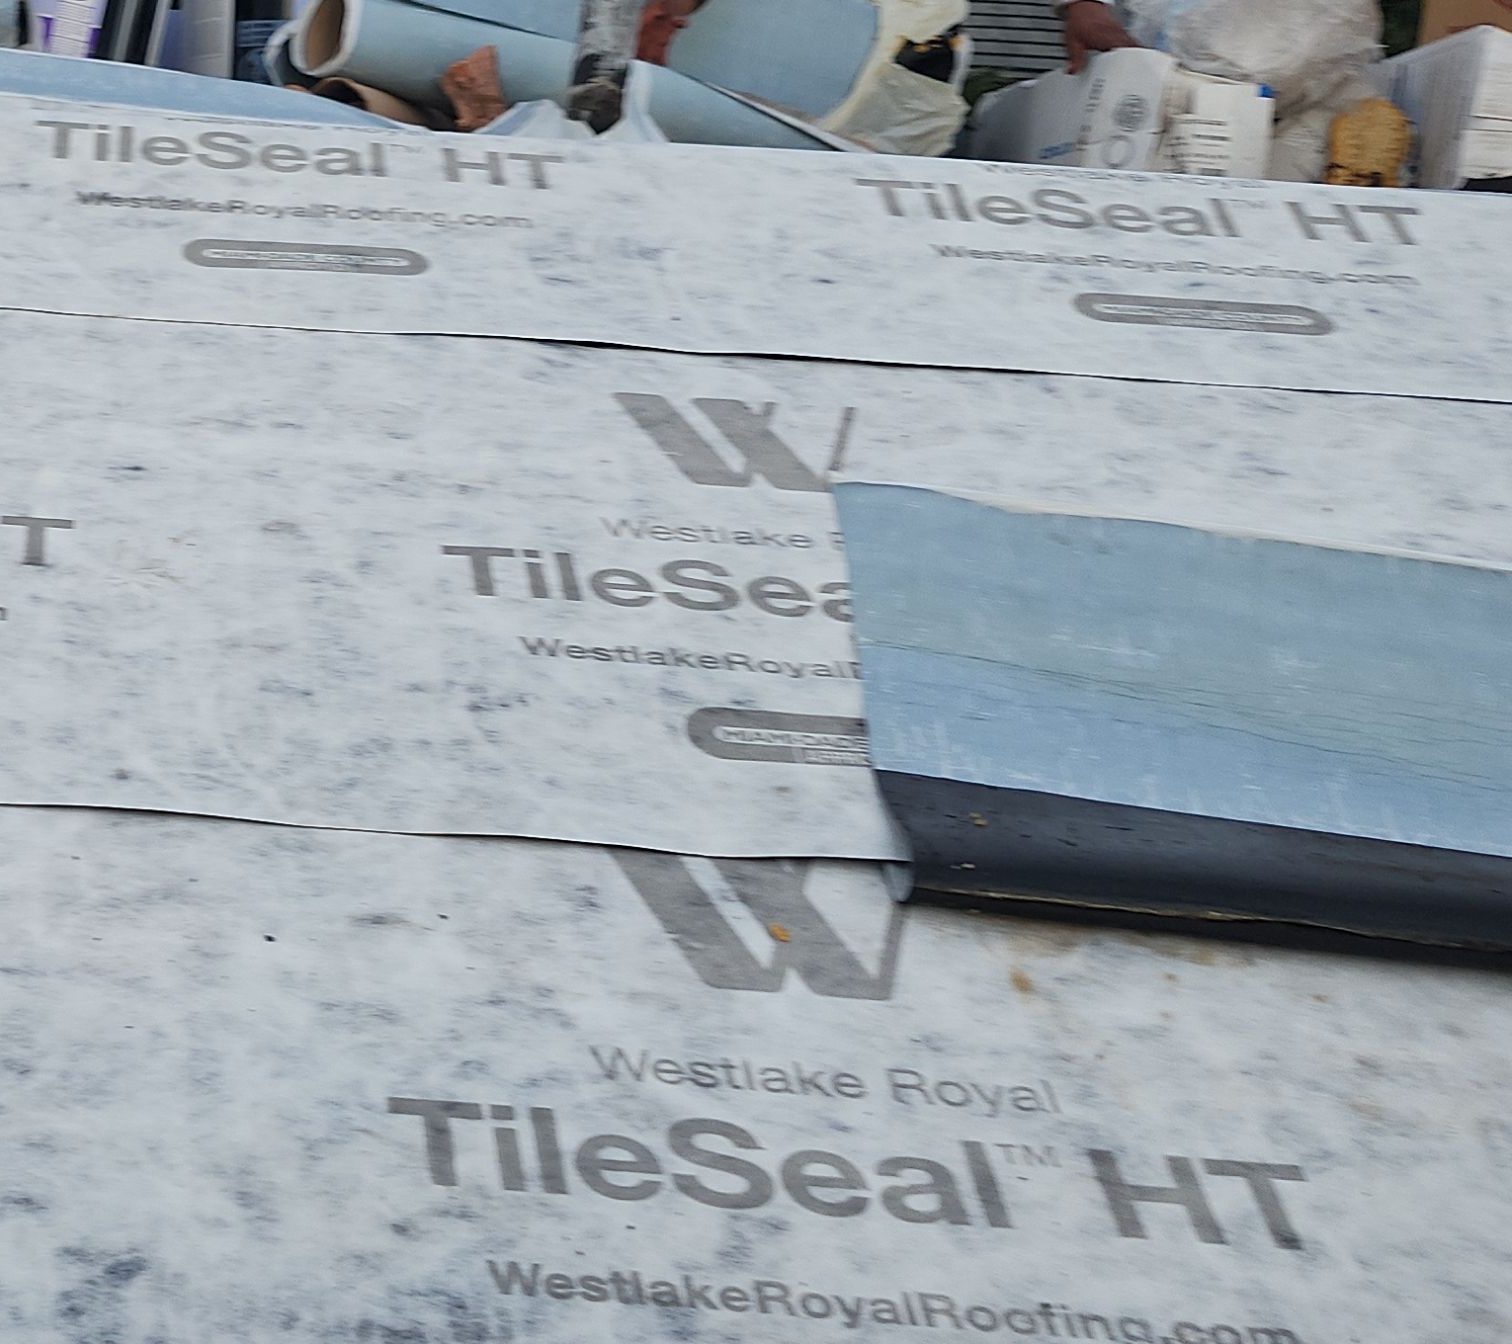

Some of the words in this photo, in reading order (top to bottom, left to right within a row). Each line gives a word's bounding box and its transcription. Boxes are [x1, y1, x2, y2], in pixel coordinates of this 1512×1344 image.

[440, 148, 562, 190] HT
[1285, 200, 1420, 245] HT
[601, 518, 812, 549] Westlake
[589, 1044, 867, 1100] Westlake
[889, 1068, 1063, 1119] Royal
[1086, 1148, 1305, 1251] HT
